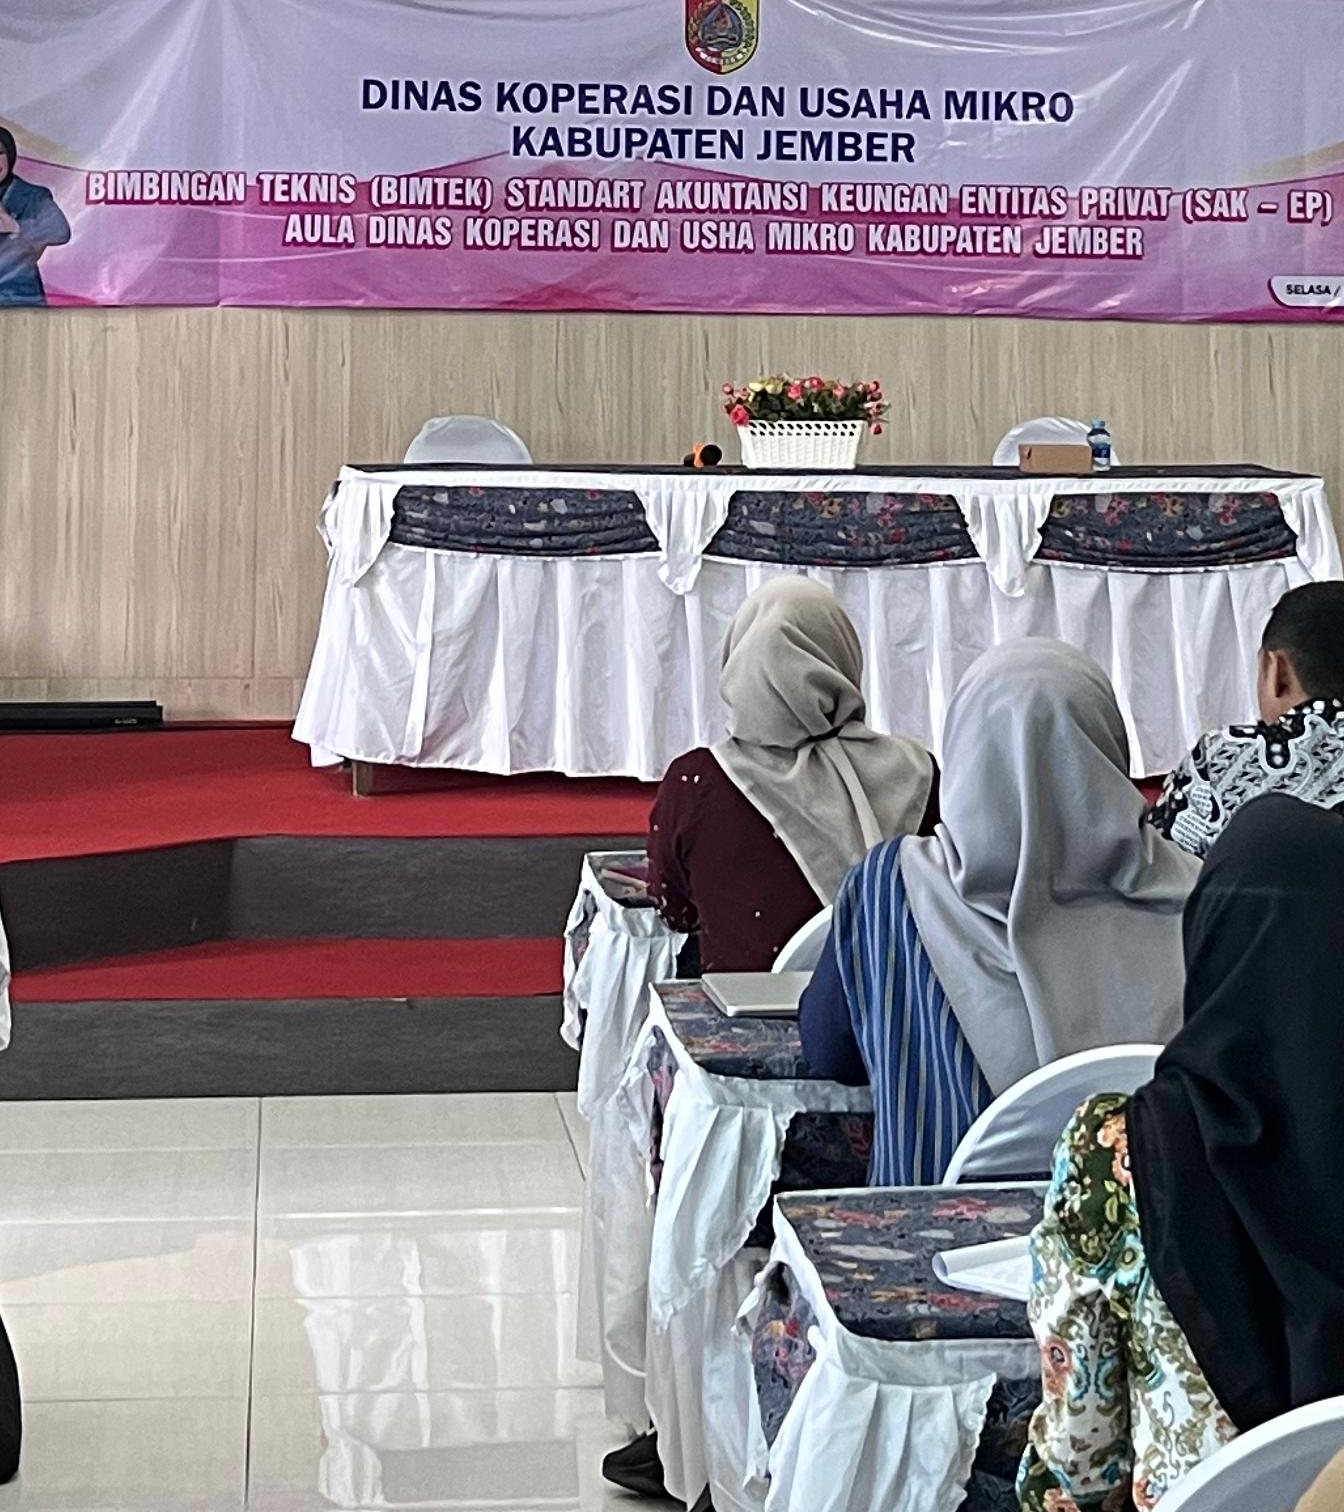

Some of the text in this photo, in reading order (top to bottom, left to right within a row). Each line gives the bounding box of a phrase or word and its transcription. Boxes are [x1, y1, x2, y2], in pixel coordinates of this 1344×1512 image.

[362, 79, 1074, 123] DINAS KOPERASI DAN USAHA MIKRO
[513, 126, 915, 163] KABUPATEN JEMBER
[86, 171, 246, 204] BIMBINGAN
[259, 172, 357, 205] TEKNIS
[371, 175, 493, 211] (BIMTEK)
[506, 179, 644, 212] STANDART
[656, 181, 808, 214] AKUNTANSI
[821, 184, 949, 215] KEUNGAN
[960, 186, 1068, 217] ENTITAS
[1081, 188, 1172, 219] PRIVAT
[1183, 189, 1249, 223] (SAK
[1288, 190, 1333, 225] EP)
[285, 215, 1144, 258] AULA DINAS KOPERASI DAN USHA MIKRO KABUPATEN JEMBER
[1285, 284, 1331, 296] SELASA
